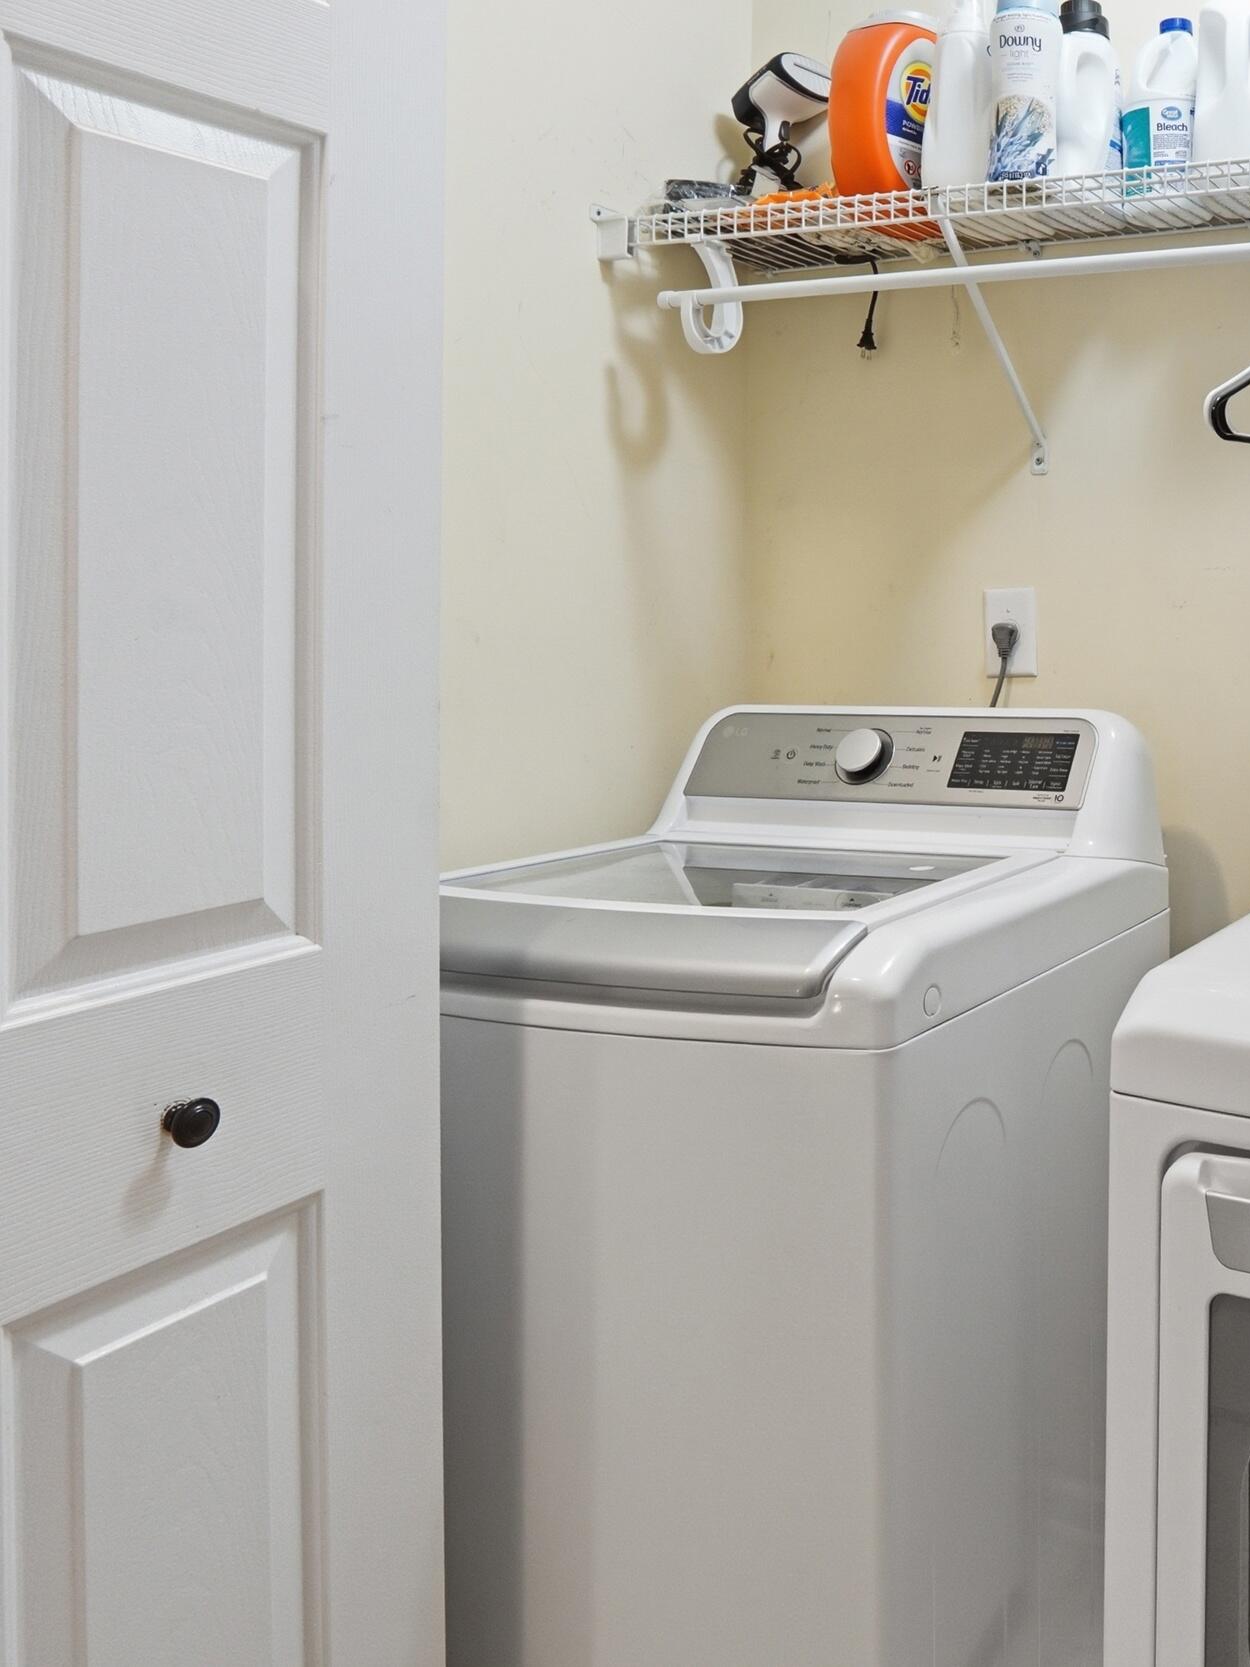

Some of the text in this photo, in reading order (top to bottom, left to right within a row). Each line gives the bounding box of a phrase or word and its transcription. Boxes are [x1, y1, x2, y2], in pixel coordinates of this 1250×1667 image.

[999, 34, 1042, 52] Downy
[905, 75, 932, 106] Tid
[1156, 122, 1189, 132] Bleach
